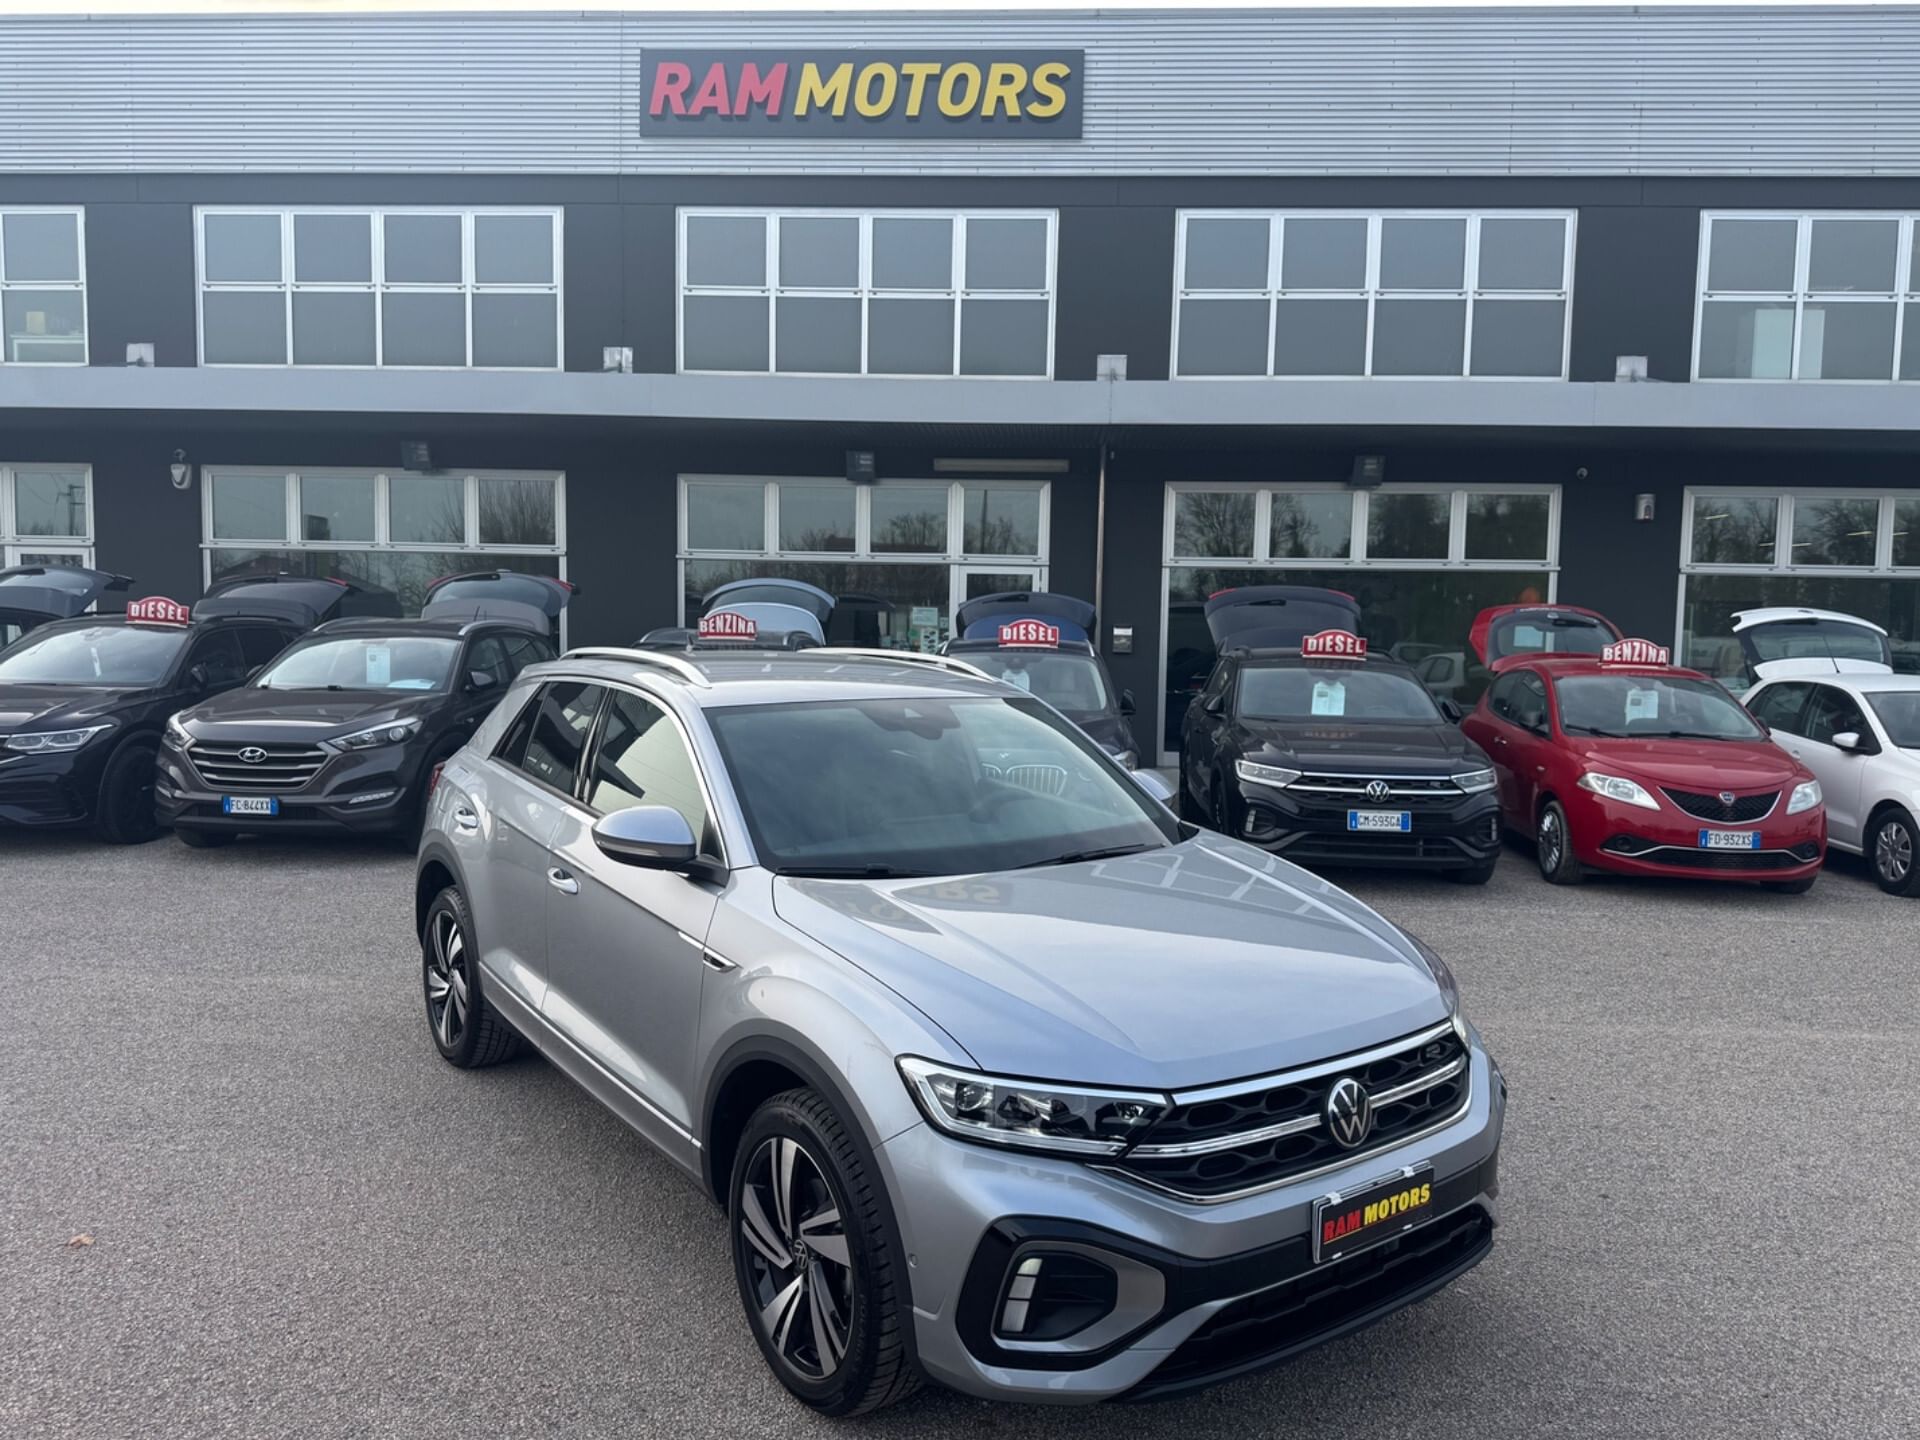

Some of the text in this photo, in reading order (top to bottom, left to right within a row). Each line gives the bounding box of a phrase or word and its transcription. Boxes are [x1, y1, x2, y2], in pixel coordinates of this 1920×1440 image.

[648, 61, 1072, 118] RAM MOTORS
[130, 601, 185, 621] DIESEL
[699, 613, 756, 634] BENZINA
[1002, 623, 1056, 642] DIESEL
[1306, 634, 1364, 654] DIESEL
[1602, 641, 1668, 664] BENZINA
[1323, 1182, 1431, 1242] RAM MOTORS
